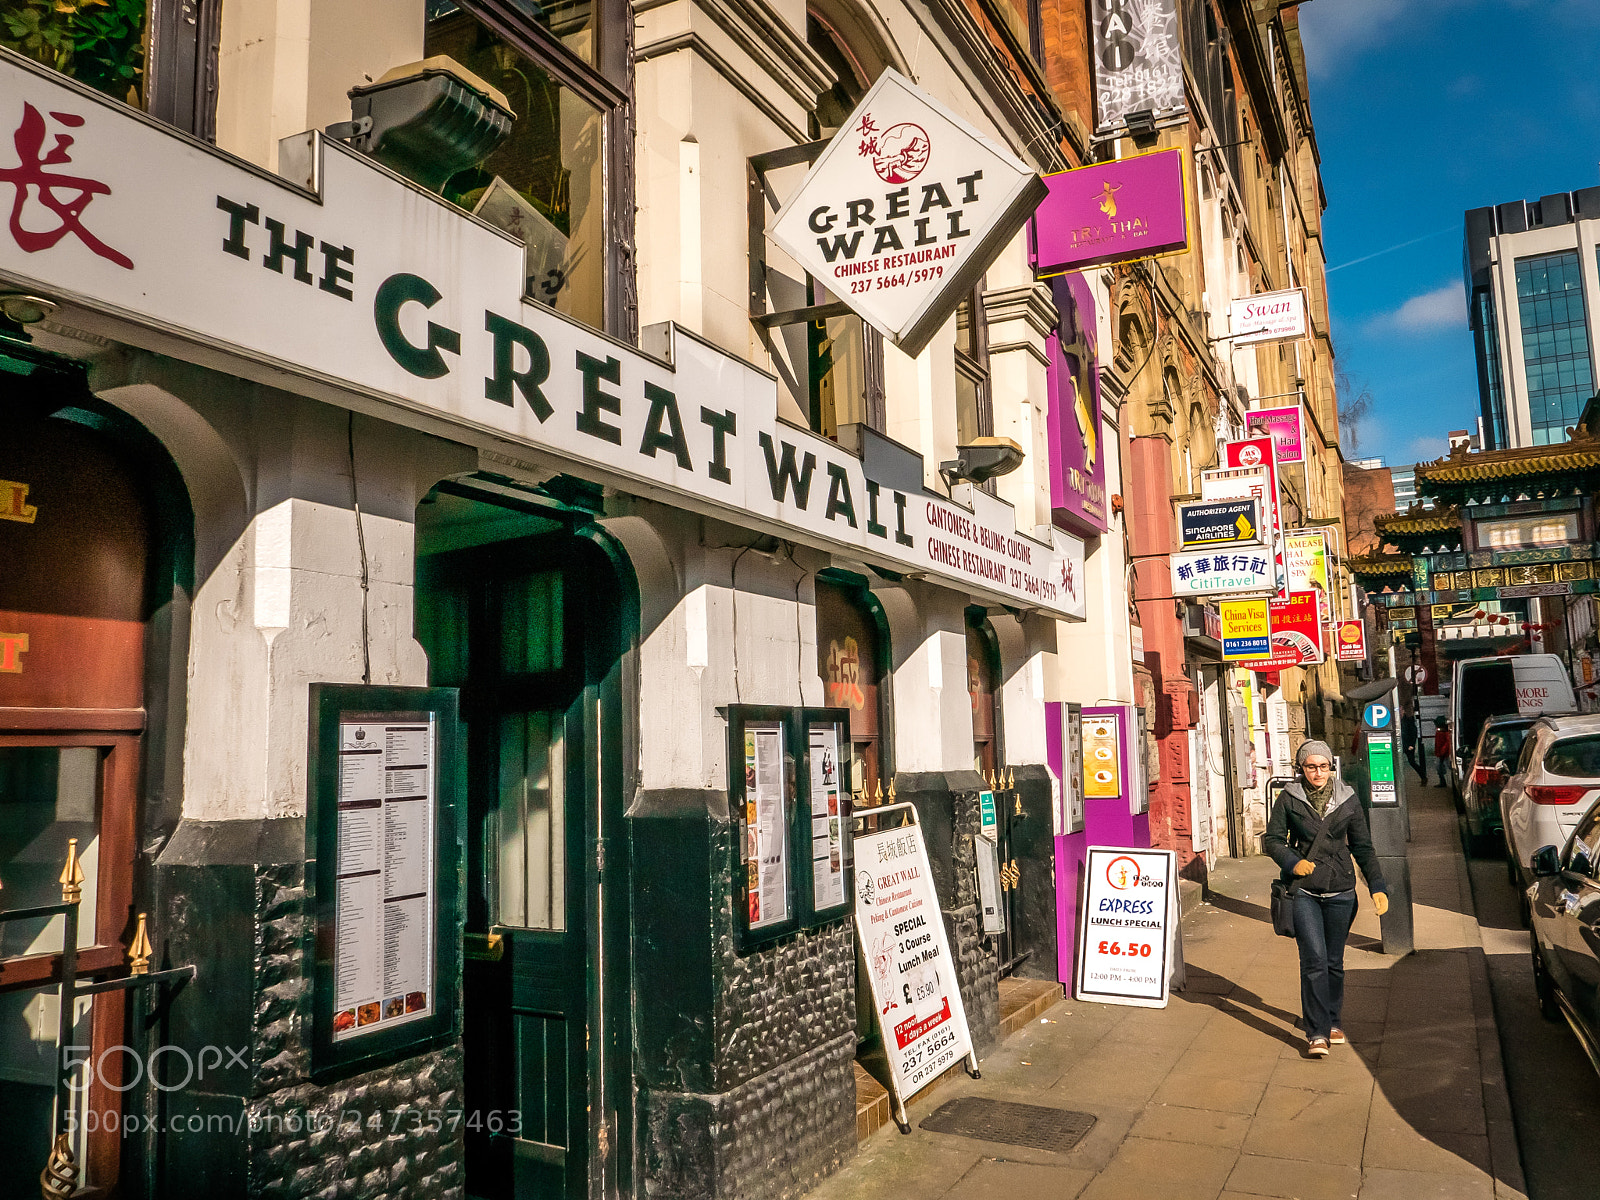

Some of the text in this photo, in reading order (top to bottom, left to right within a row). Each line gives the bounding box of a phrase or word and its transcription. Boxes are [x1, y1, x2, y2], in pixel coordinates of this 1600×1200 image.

[0, 101, 134, 270] 長
[808, 169, 983, 233] GREAT
[817, 210, 970, 263] WALL
[1070, 216, 1149, 242] TRY THAI
[217, 195, 355, 301] THE
[834, 244, 957, 278] CHINESE RESTAURANT
[851, 265, 943, 294] 237 5664/5979
[1243, 301, 1291, 320] Swan
[374, 272, 913, 548] GREAT WALL
[1249, 414, 1296, 425] Thai Massage
[1290, 425, 1297, 434] &
[1280, 437, 1298, 446] Hair
[1276, 450, 1299, 460] Salon
[1187, 504, 1251, 517] AUTHORIZED AGENT
[926, 501, 1032, 566] CANTONESE & BEIJING CUISINE
[1185, 523, 1234, 536] SINGAPORE
[1195, 530, 1235, 541] AIRLINES
[1287, 539, 1323, 549] AMEASE
[1286, 550, 1303, 558] HAI
[1289, 558, 1320, 568] ASSAGE
[928, 536, 1057, 601] CHINESE RESTAURANT 237 5664/5979
[1177, 555, 1267, 580] 新華旅行社
[1291, 569, 1306, 577] SPA
[1190, 574, 1255, 589] CitiTravel
[1224, 608, 1265, 622] China Visa
[1228, 621, 1263, 634] Services
[1225, 639, 1268, 648] 0161 236 8018
[1518, 699, 1544, 708] INGS
[1372, 705, 1387, 727] P
[877, 866, 920, 890] GREAT WALL
[876, 888, 912, 907] Chinese Restaurant
[1099, 898, 1154, 915] EXPRESS
[870, 911, 885, 925] Peking
[884, 910, 889, 919] &
[894, 915, 926, 937] SPECIAL
[1091, 917, 1162, 928] LUNCH SPECIAL
[898, 932, 931, 953] 3 Course
[1098, 940, 1152, 958] £6.50
[898, 945, 940, 974] Lunch Meal
[1090, 972, 1109, 980] 12:00
[1109, 973, 1122, 982] PM
[916, 981, 935, 1001] £5.90
[895, 1026, 904, 1036] 12
[903, 1034, 909, 1043] 7
[908, 1025, 923, 1039] days
[927, 1013, 943, 1028] week
[931, 1025, 951, 1042] (0161)
[902, 1032, 956, 1074] 237 5664
[912, 1050, 954, 1084] OR 237 5979
